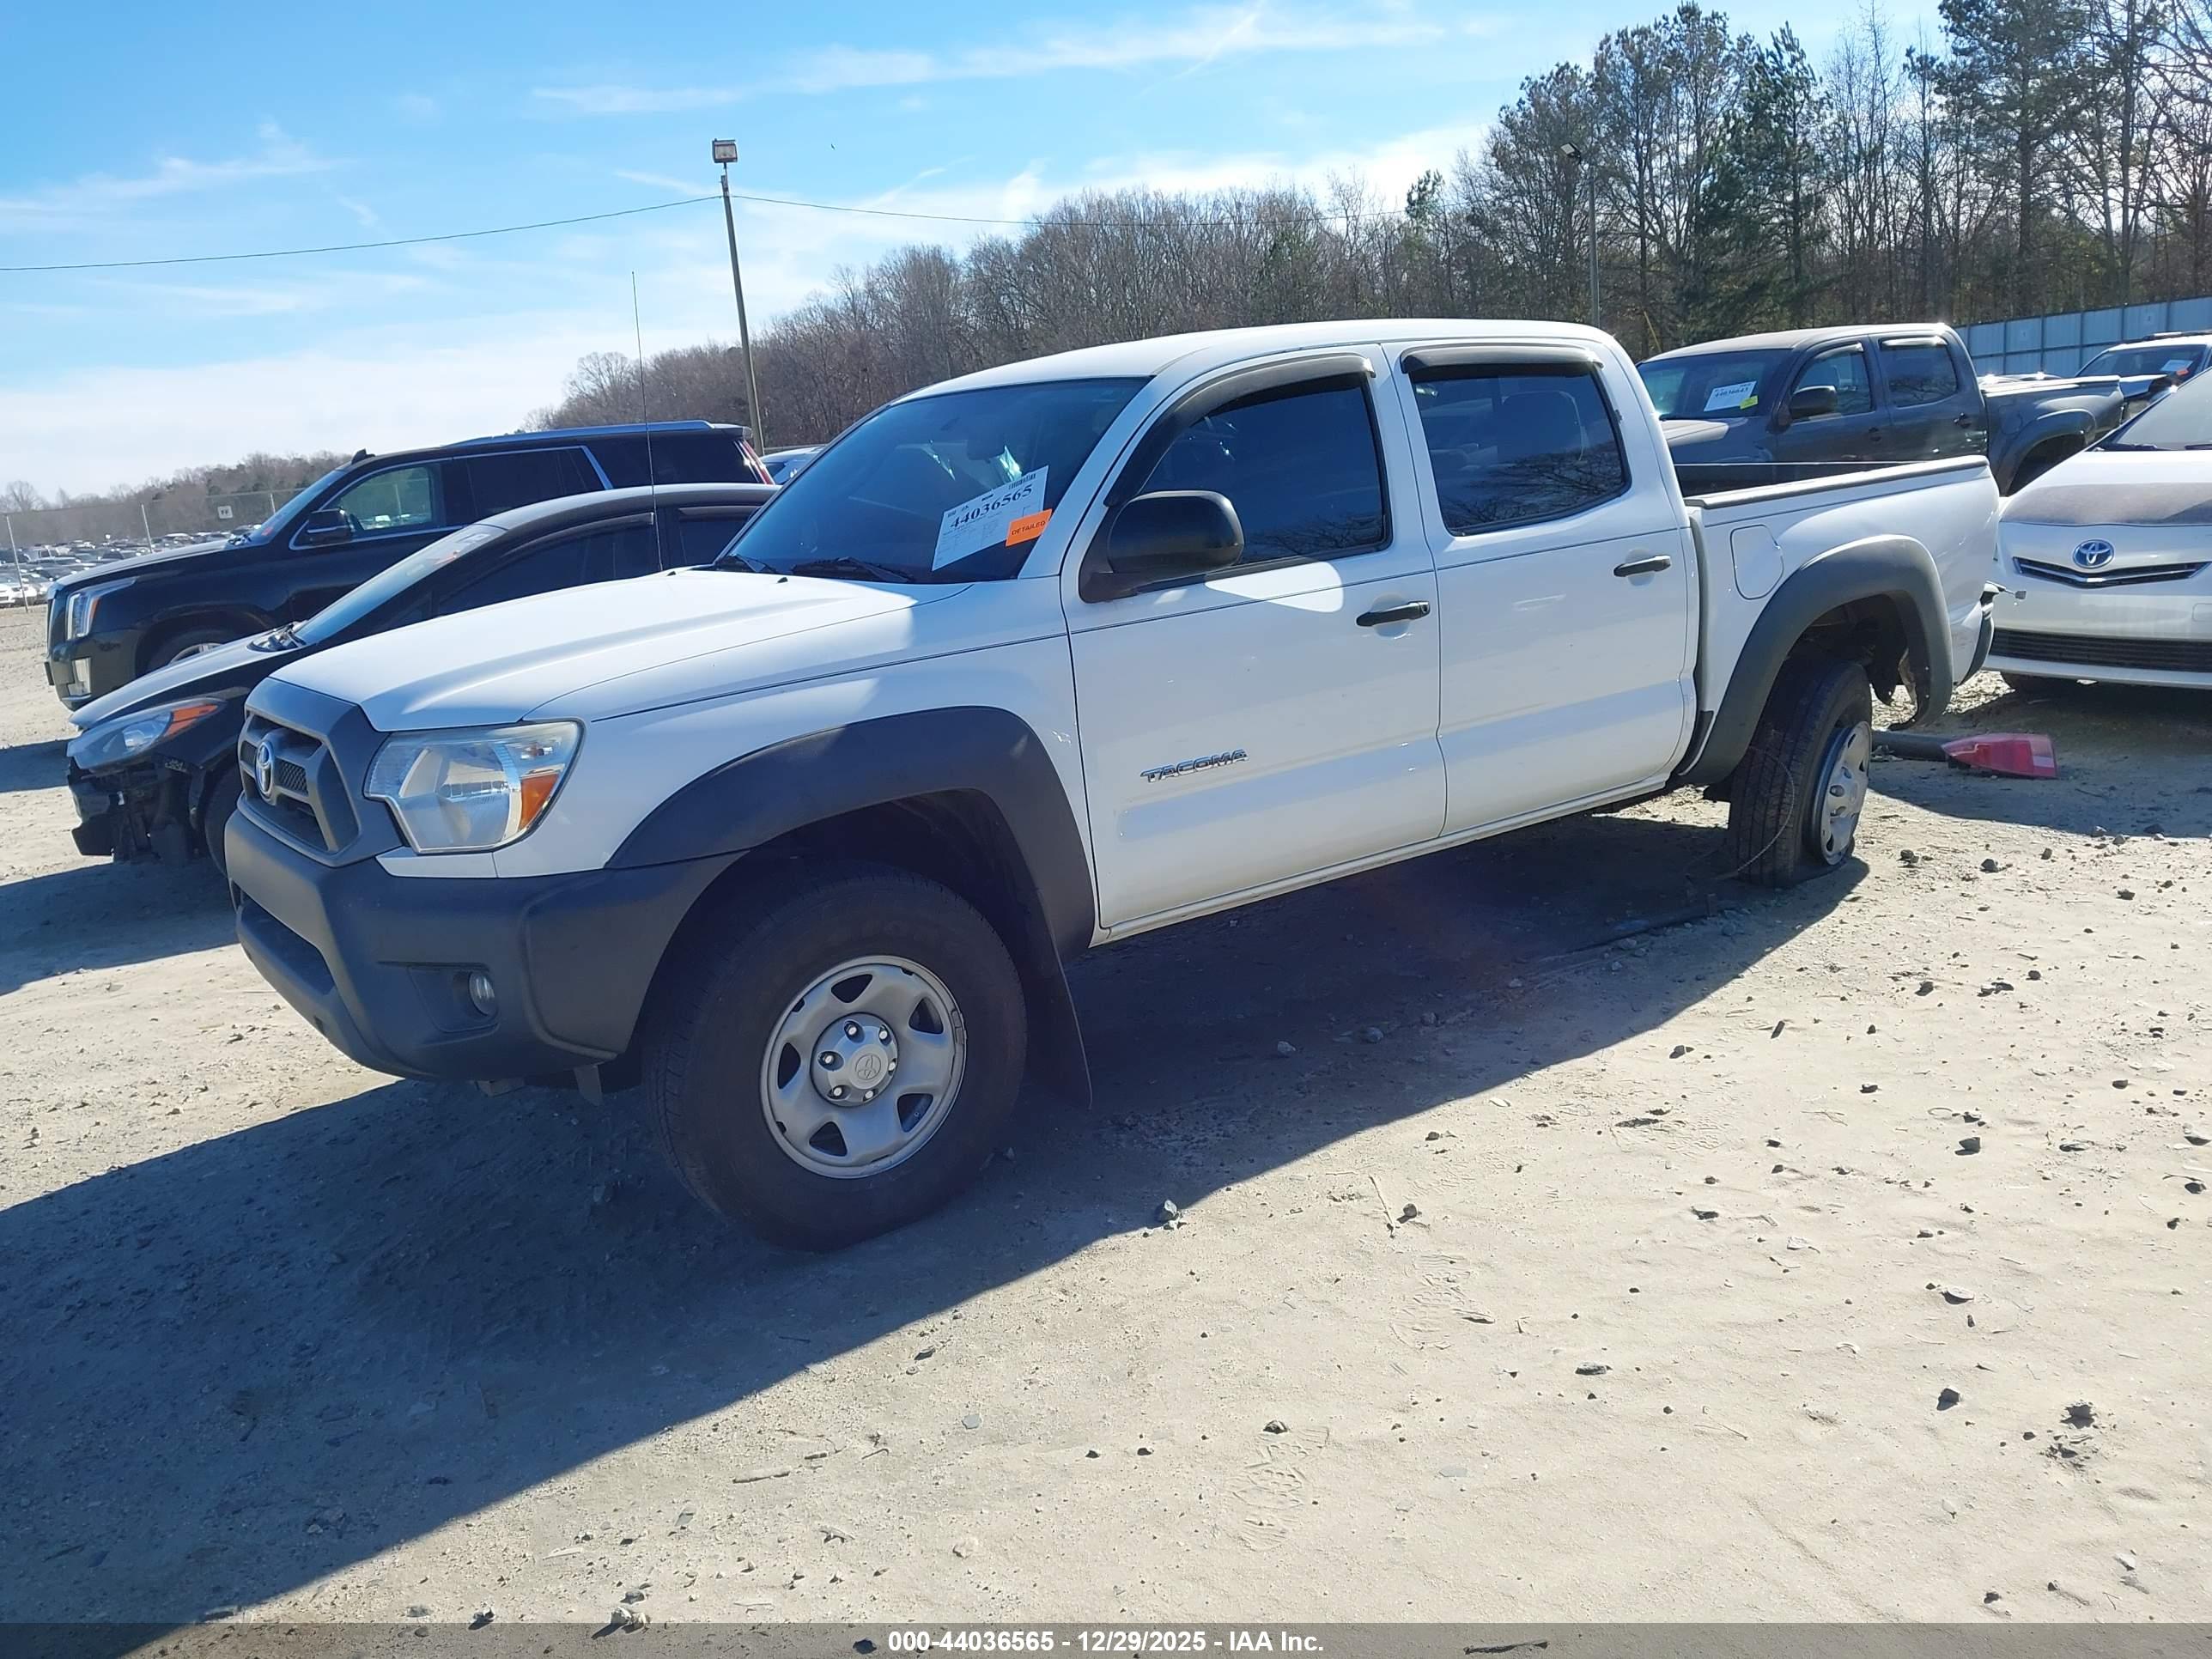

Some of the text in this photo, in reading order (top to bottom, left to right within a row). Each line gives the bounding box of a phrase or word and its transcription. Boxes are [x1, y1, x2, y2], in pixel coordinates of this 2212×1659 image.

[950, 483, 1033, 528] 44036565
[1012, 520, 1046, 536] DETAILED
[1139, 749, 1250, 783] TACOMA
